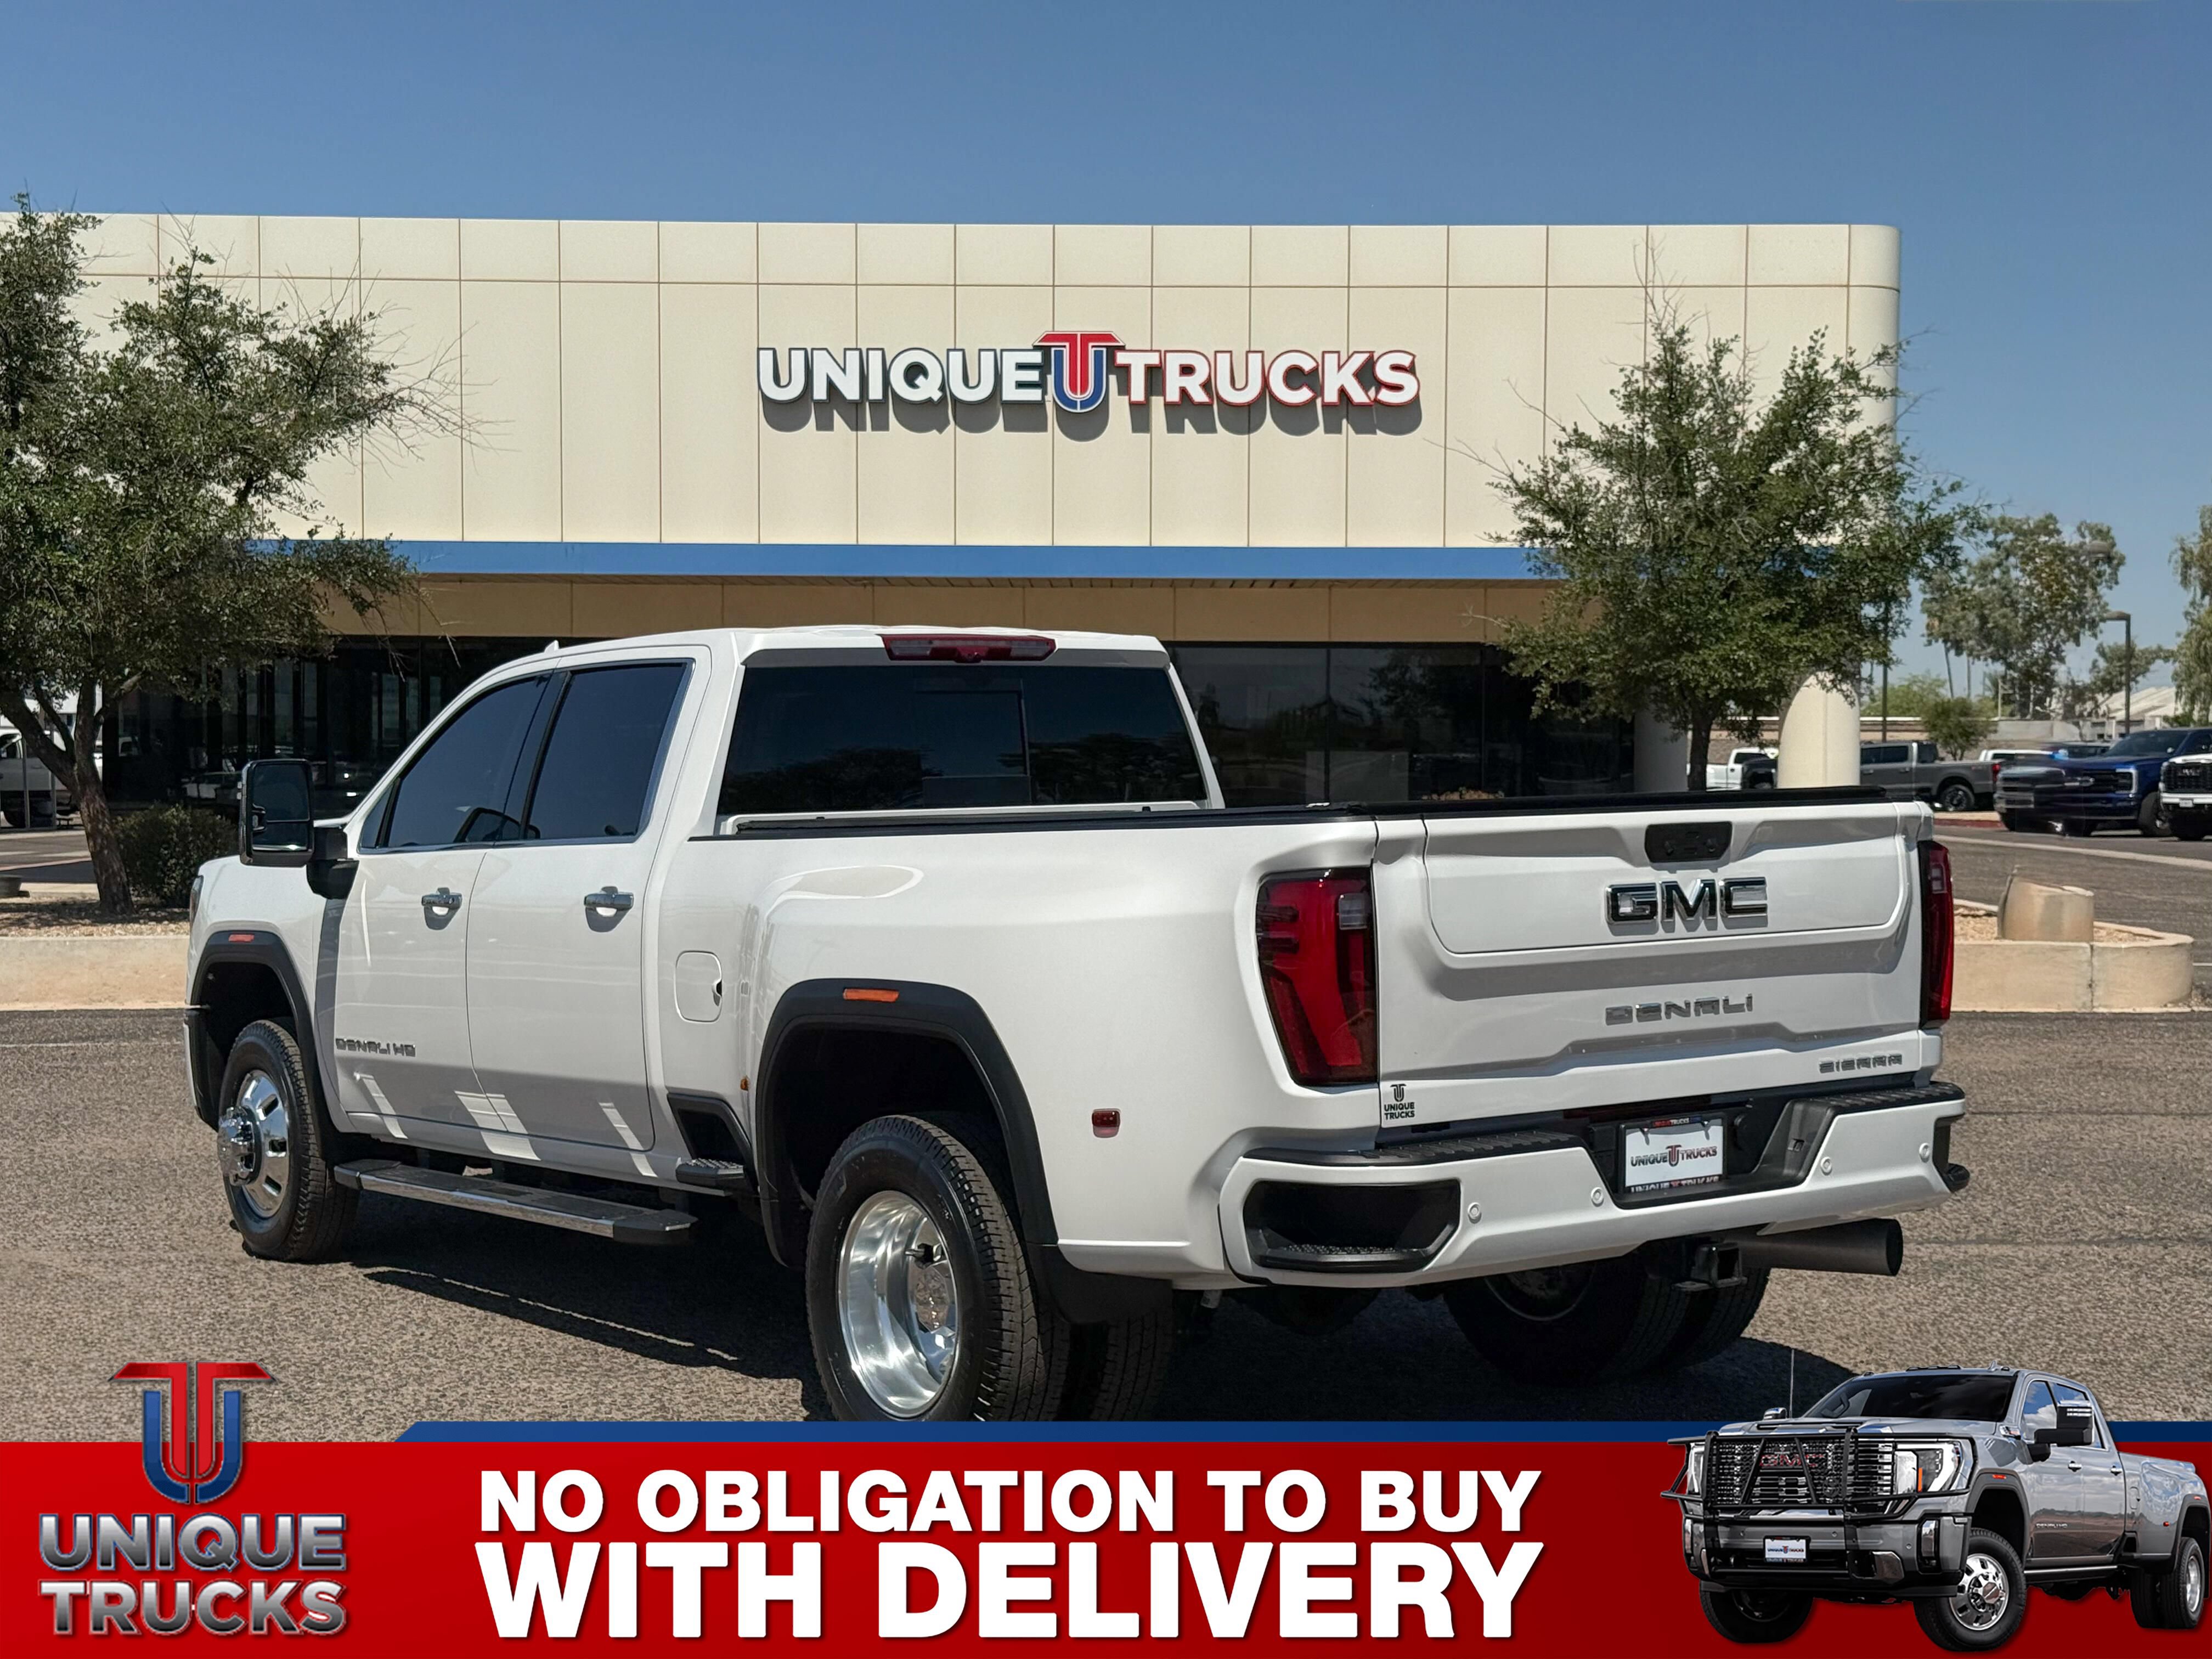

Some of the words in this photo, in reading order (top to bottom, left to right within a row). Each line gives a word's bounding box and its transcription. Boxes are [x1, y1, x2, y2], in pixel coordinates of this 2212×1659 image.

[758, 347, 1044, 404] UNIQUE
[1114, 349, 1420, 407] TRUCKS
[1605, 876, 1768, 925] GMC
[1605, 993, 1753, 1025] DENALI
[335, 1038, 390, 1055] DENALI
[393, 1043, 416, 1057] HD
[1819, 1053, 1902, 1073] SIERRA
[1384, 1102, 1415, 1111] UNIQUE
[1384, 1110, 1415, 1120] TRUCKS
[1630, 1153, 1668, 1167] UNIQUE
[1680, 1146, 1718, 1161] TRUCKS
